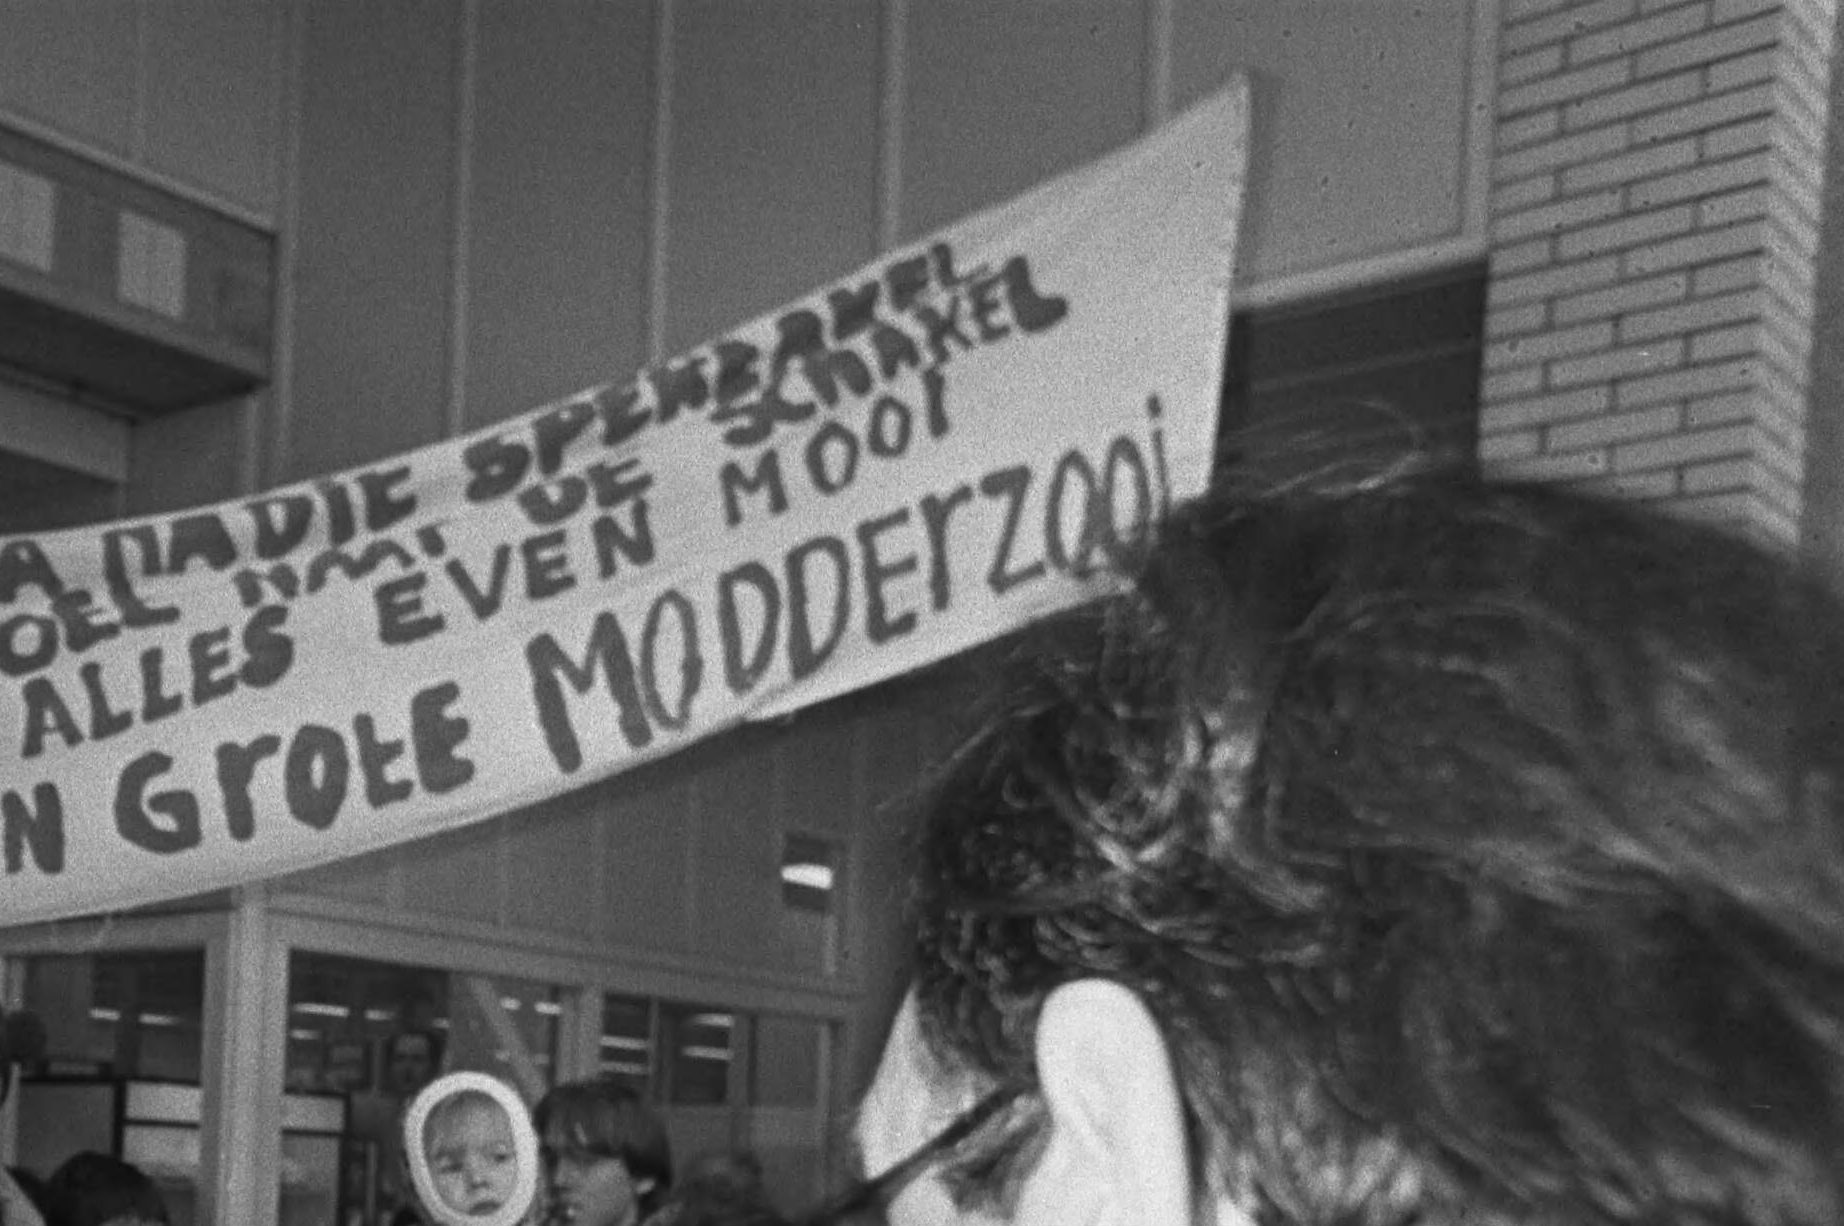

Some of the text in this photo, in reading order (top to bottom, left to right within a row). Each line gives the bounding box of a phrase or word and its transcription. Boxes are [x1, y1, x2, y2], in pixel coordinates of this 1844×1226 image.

[22, 604, 294, 757] ALLES
[374, 498, 656, 645] EVEN
[719, 367, 949, 528] MOOI
